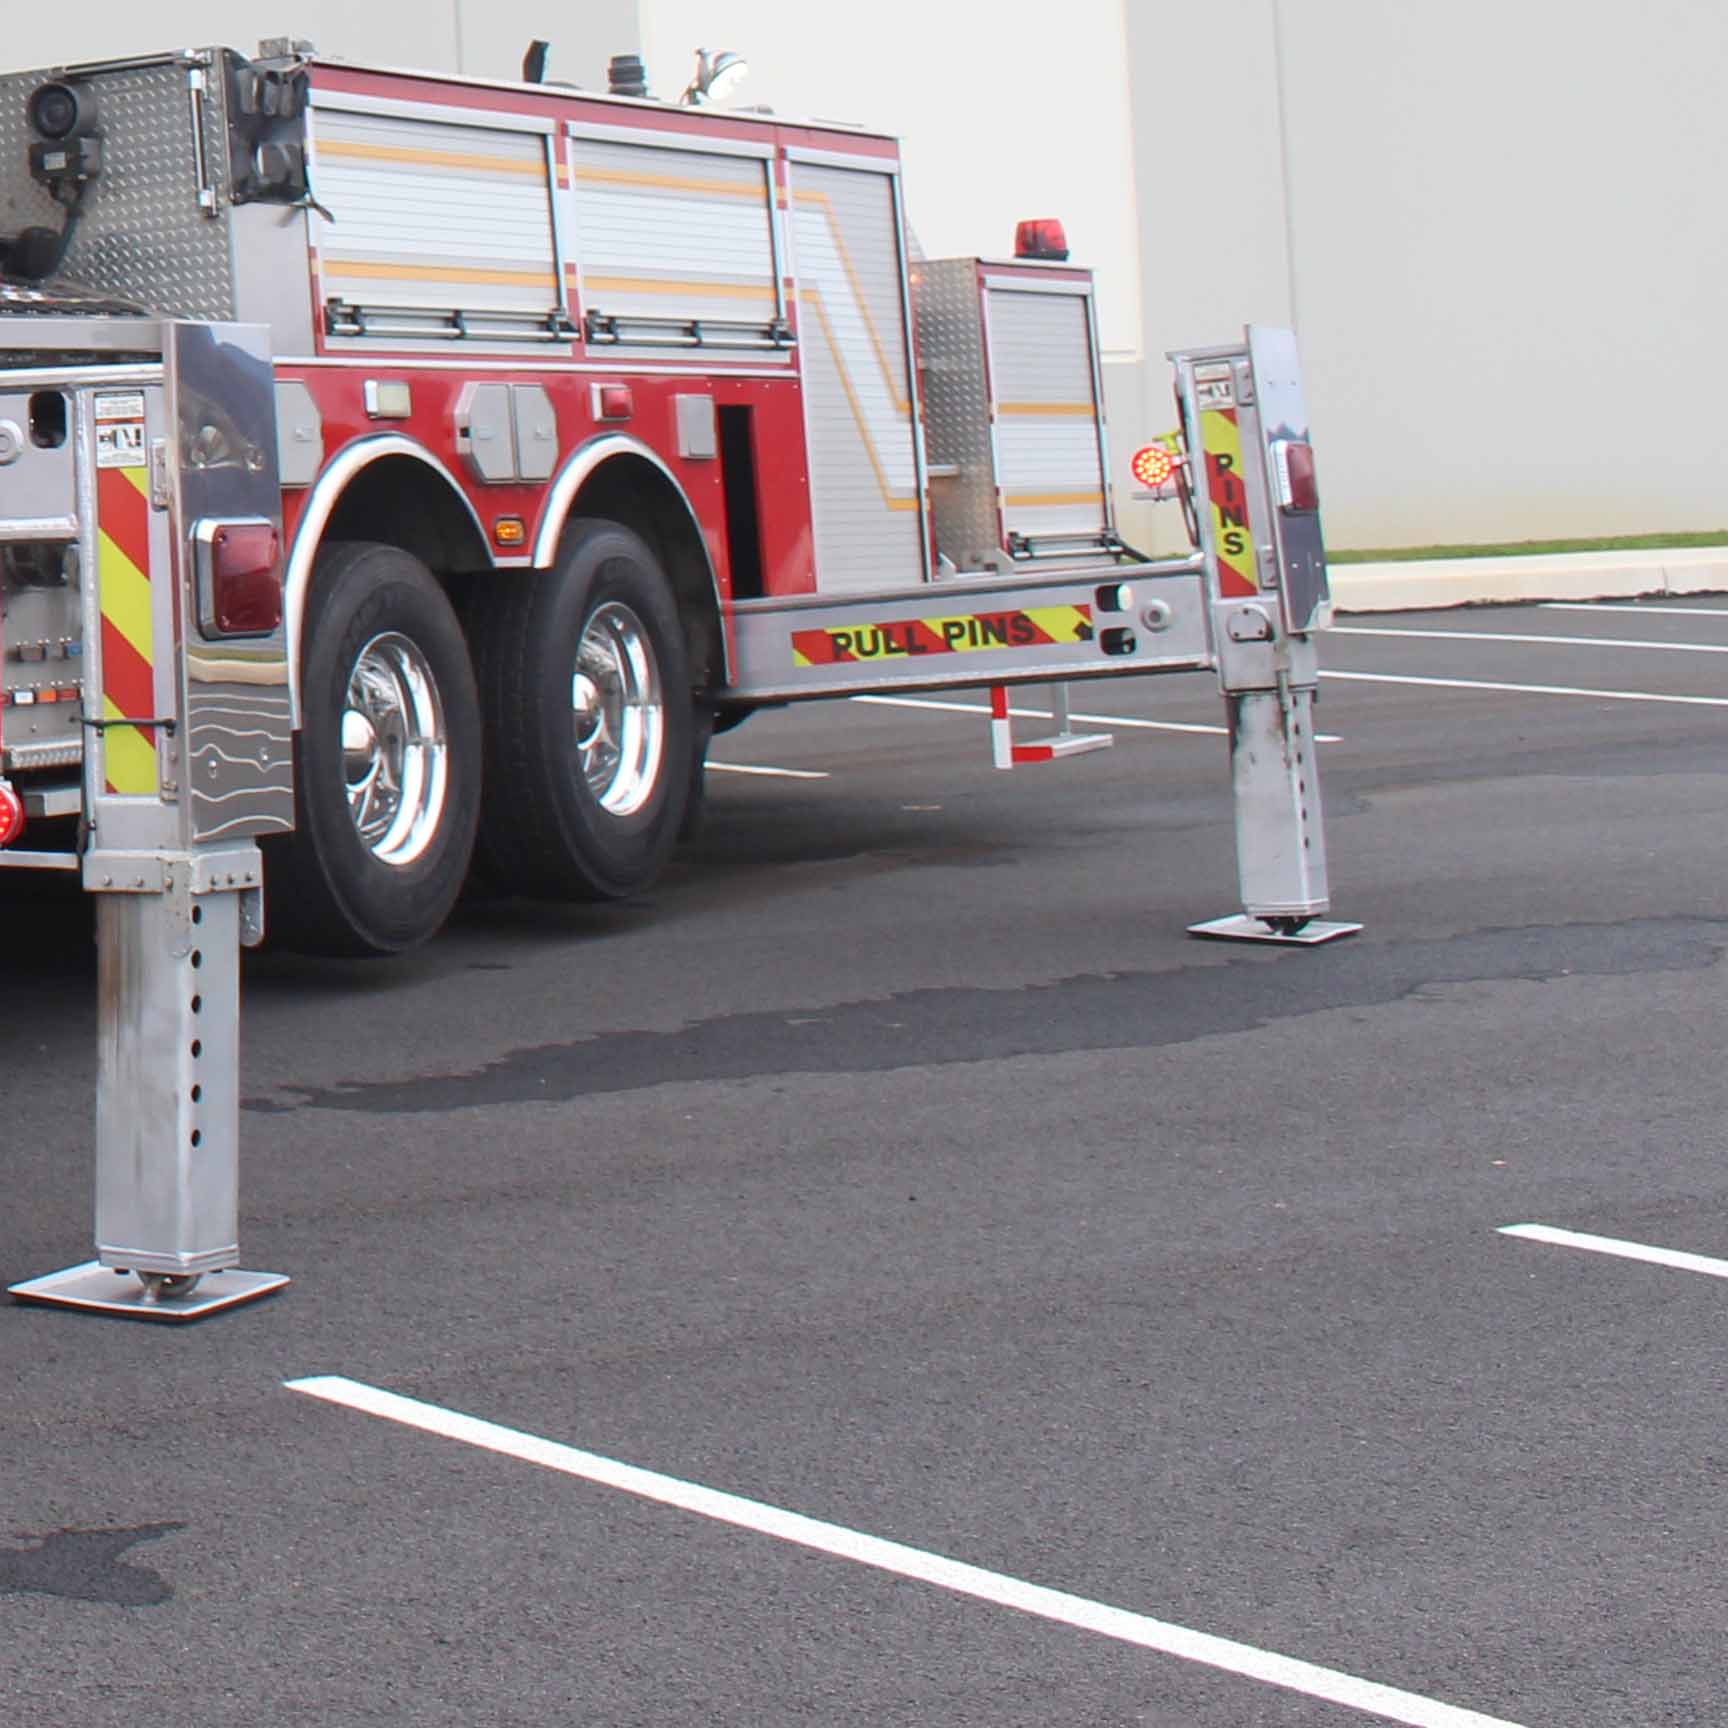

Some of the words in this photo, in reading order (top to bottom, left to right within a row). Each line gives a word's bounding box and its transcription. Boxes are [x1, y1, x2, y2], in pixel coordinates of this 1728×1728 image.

[1216, 453, 1244, 555] PINS
[831, 626, 927, 661] PULL
[942, 613, 1035, 647] PINS
